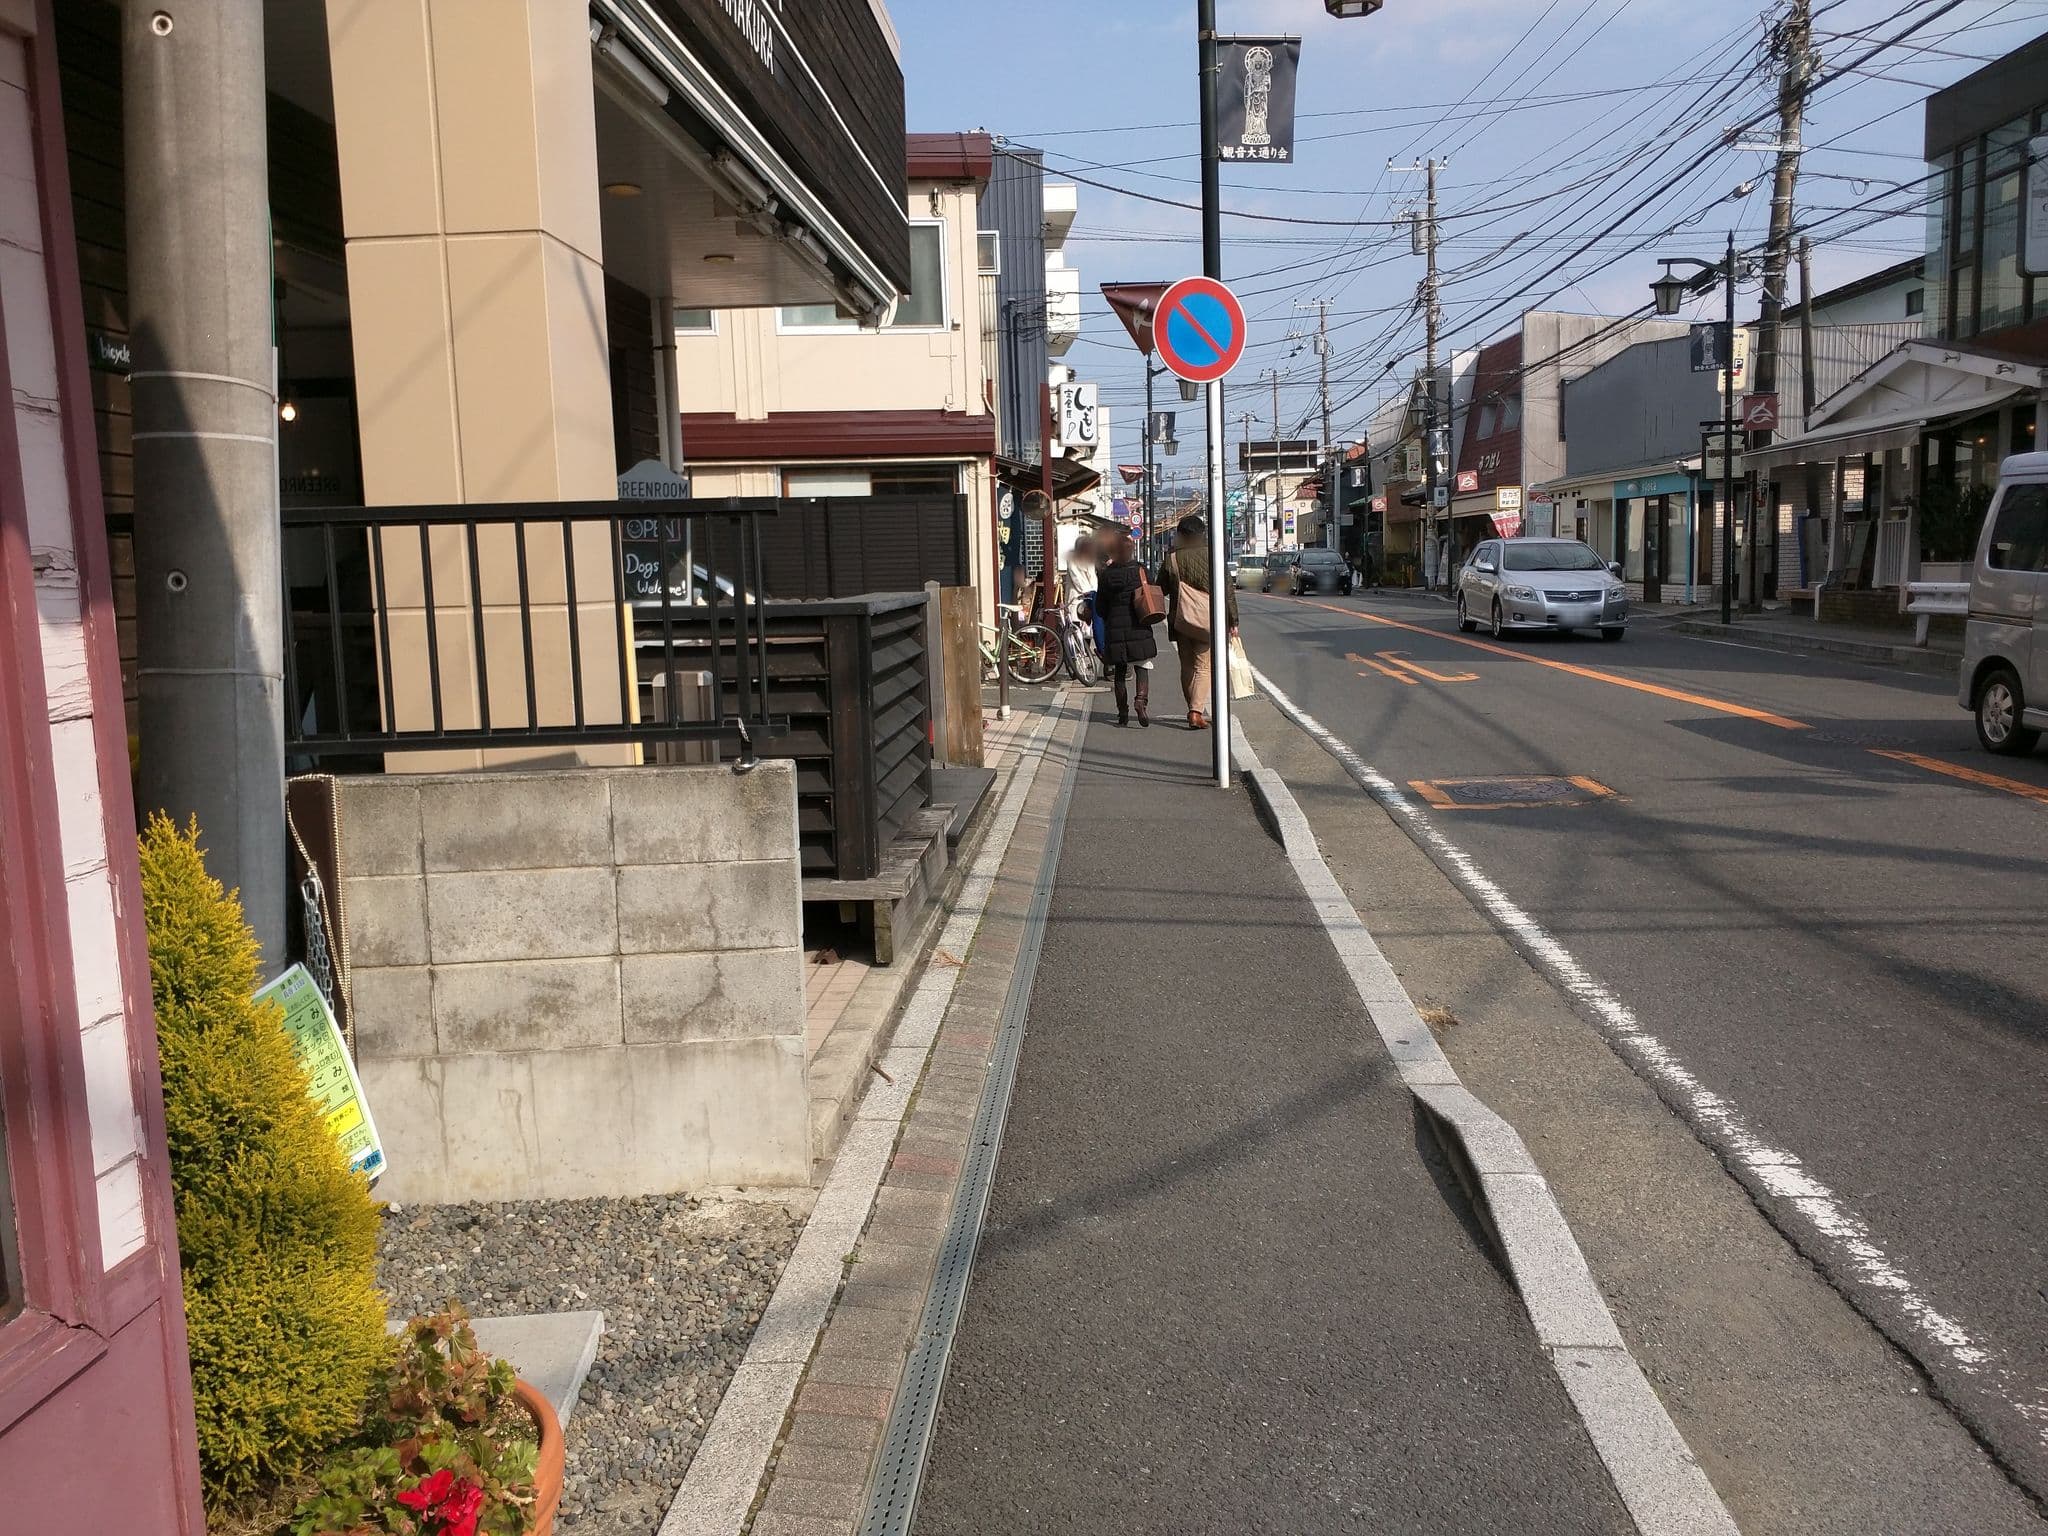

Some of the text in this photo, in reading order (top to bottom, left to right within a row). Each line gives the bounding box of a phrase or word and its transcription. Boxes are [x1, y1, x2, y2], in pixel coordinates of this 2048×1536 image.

[719, 0, 774, 75] AKURA
[1222, 145, 1289, 160] 観音大通り会
[1074, 387, 1095, 441] しゃもじ
[626, 553, 660, 579] Dogs
[637, 579, 687, 597] Welcme!
